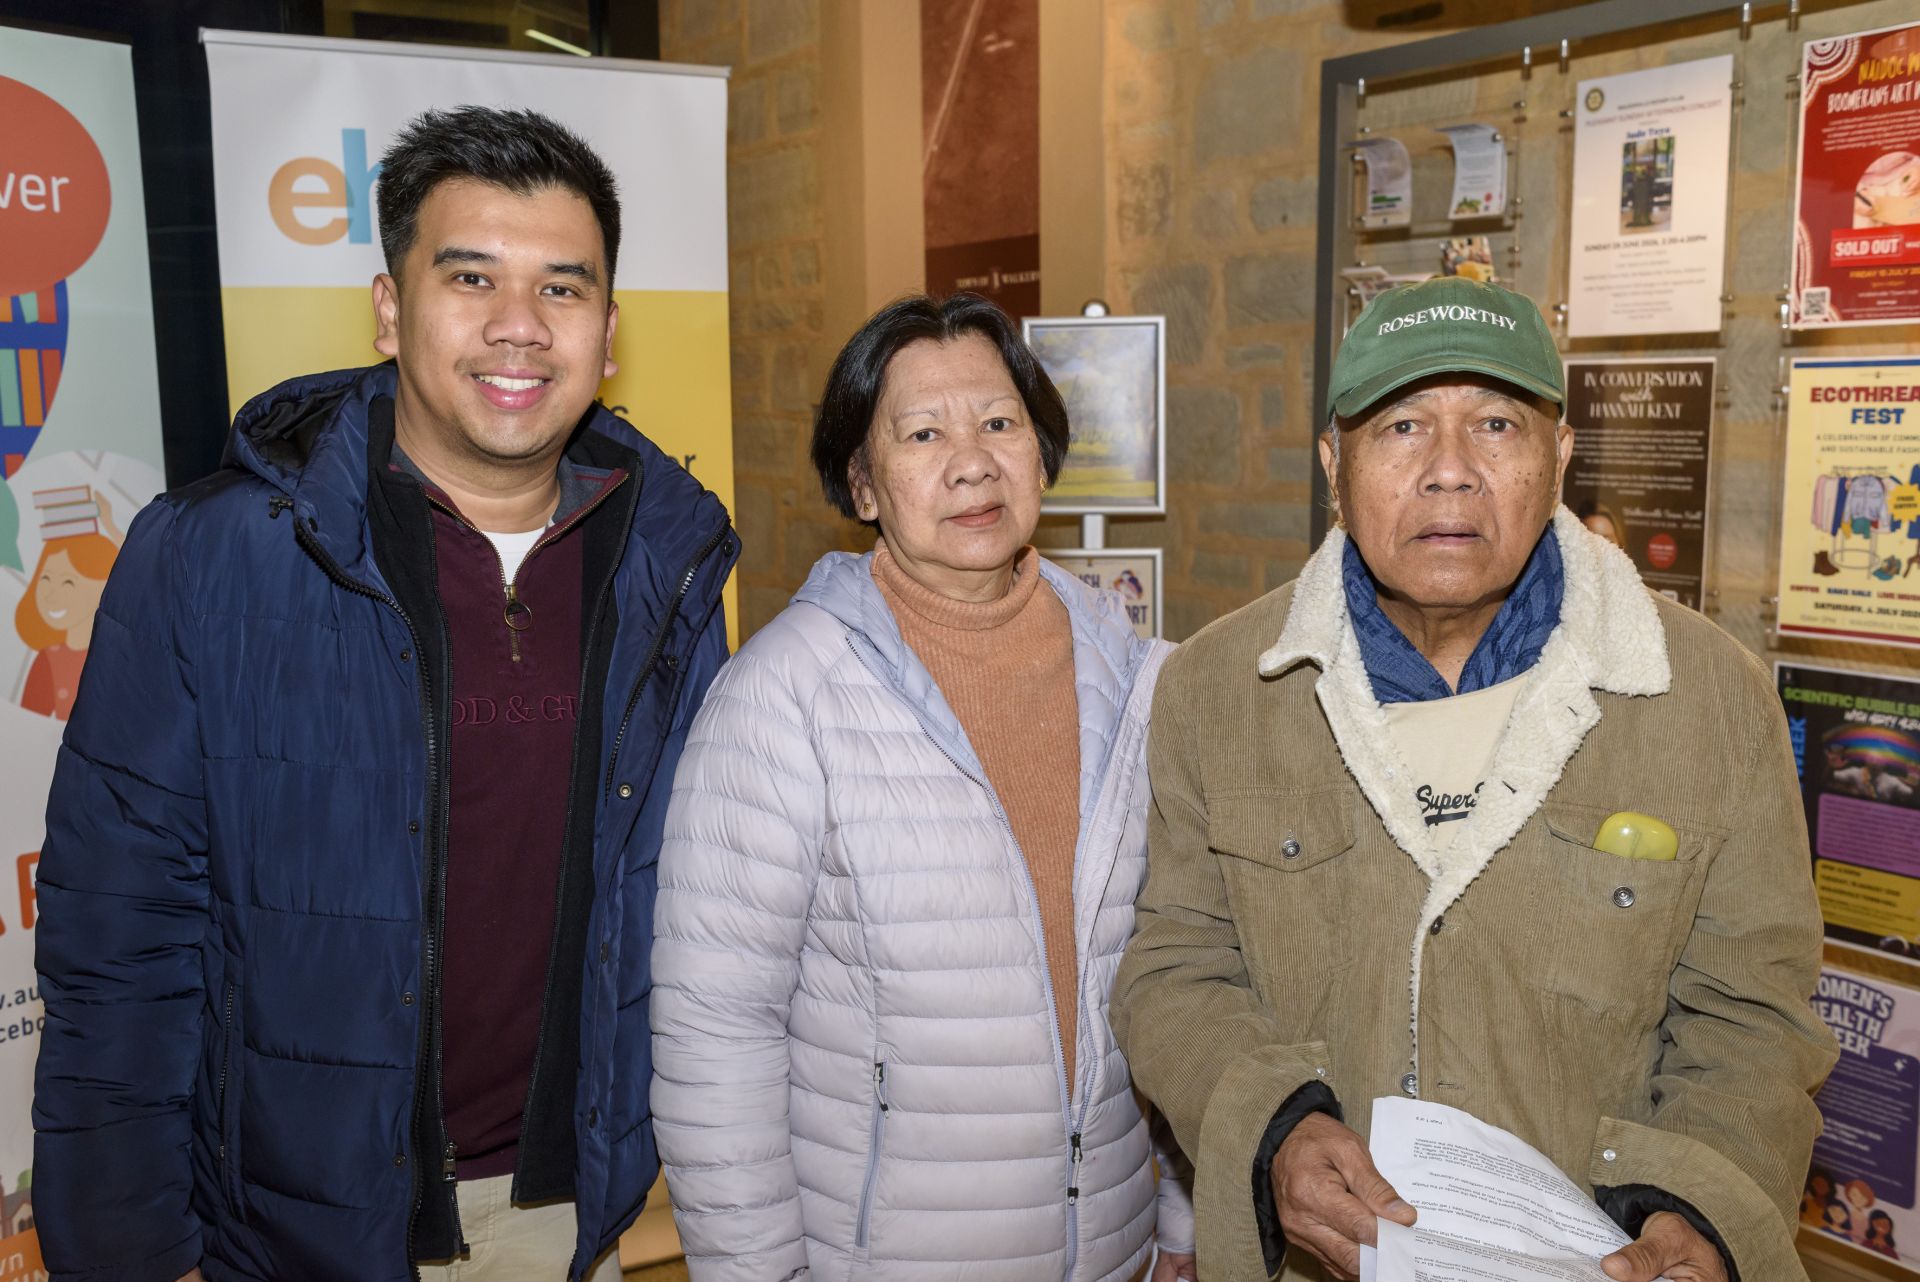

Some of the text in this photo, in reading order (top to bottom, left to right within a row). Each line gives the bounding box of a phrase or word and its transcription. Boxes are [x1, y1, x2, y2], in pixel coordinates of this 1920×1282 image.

[1835, 240, 1870, 257] SOLD
[1871, 238, 1899, 255] OUT
[1377, 305, 1517, 337] ROSEWORTHY
[1600, 370, 1704, 388] CONVERSATION
[1647, 402, 1684, 419] KENT
[1850, 408, 1906, 425] FEST
[505, 695, 537, 723] &
[1783, 687, 1855, 709] SCIENTIFIC
[1416, 782, 1485, 826] Super
[1813, 976, 1893, 1018] OMEN'S
[1810, 1001, 1881, 1041] EALTH
[1832, 1026, 1869, 1057] EEK
